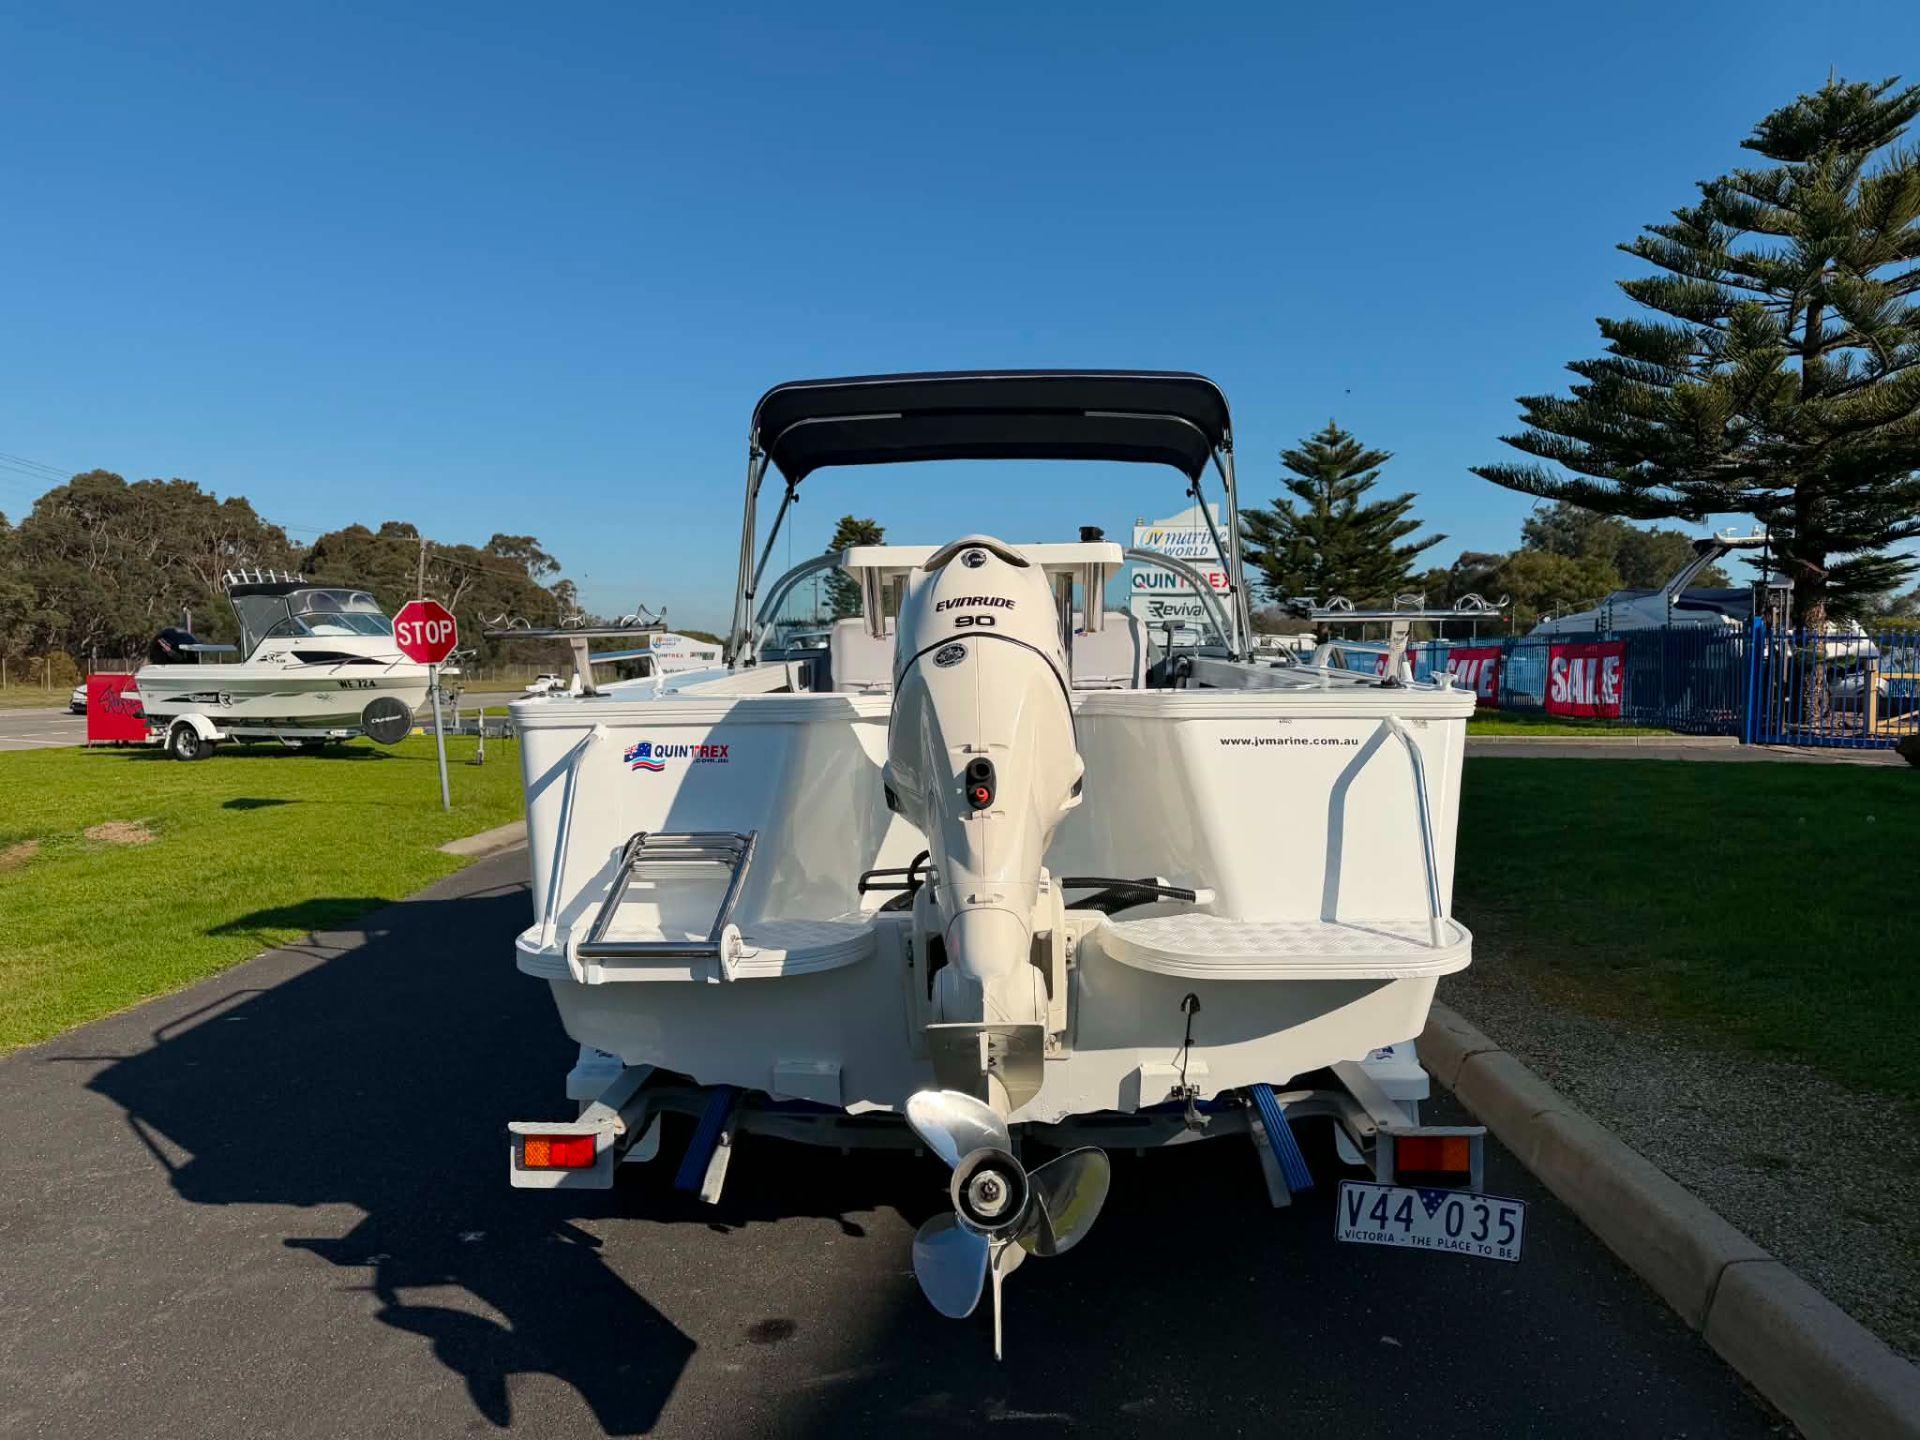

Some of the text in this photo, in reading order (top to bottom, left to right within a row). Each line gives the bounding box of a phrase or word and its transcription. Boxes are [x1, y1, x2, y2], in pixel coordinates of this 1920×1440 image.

[1164, 546, 1208, 556] WORLD
[936, 596, 1017, 612] EVINRUDE
[955, 615, 996, 627] 90
[397, 620, 452, 646] STOP
[1551, 656, 1620, 704] SALE
[1220, 736, 1359, 747] www.jvmarine.com.au
[655, 745, 729, 758] QUINTREX
[1347, 1189, 1517, 1245] V44 035
[1344, 1230, 1394, 1243] VICTORIA
[1411, 1235, 1431, 1246] THE
[1438, 1238, 1471, 1252] PLACE
[1477, 1244, 1492, 1255] TO
[1499, 1247, 1513, 1259] BE
